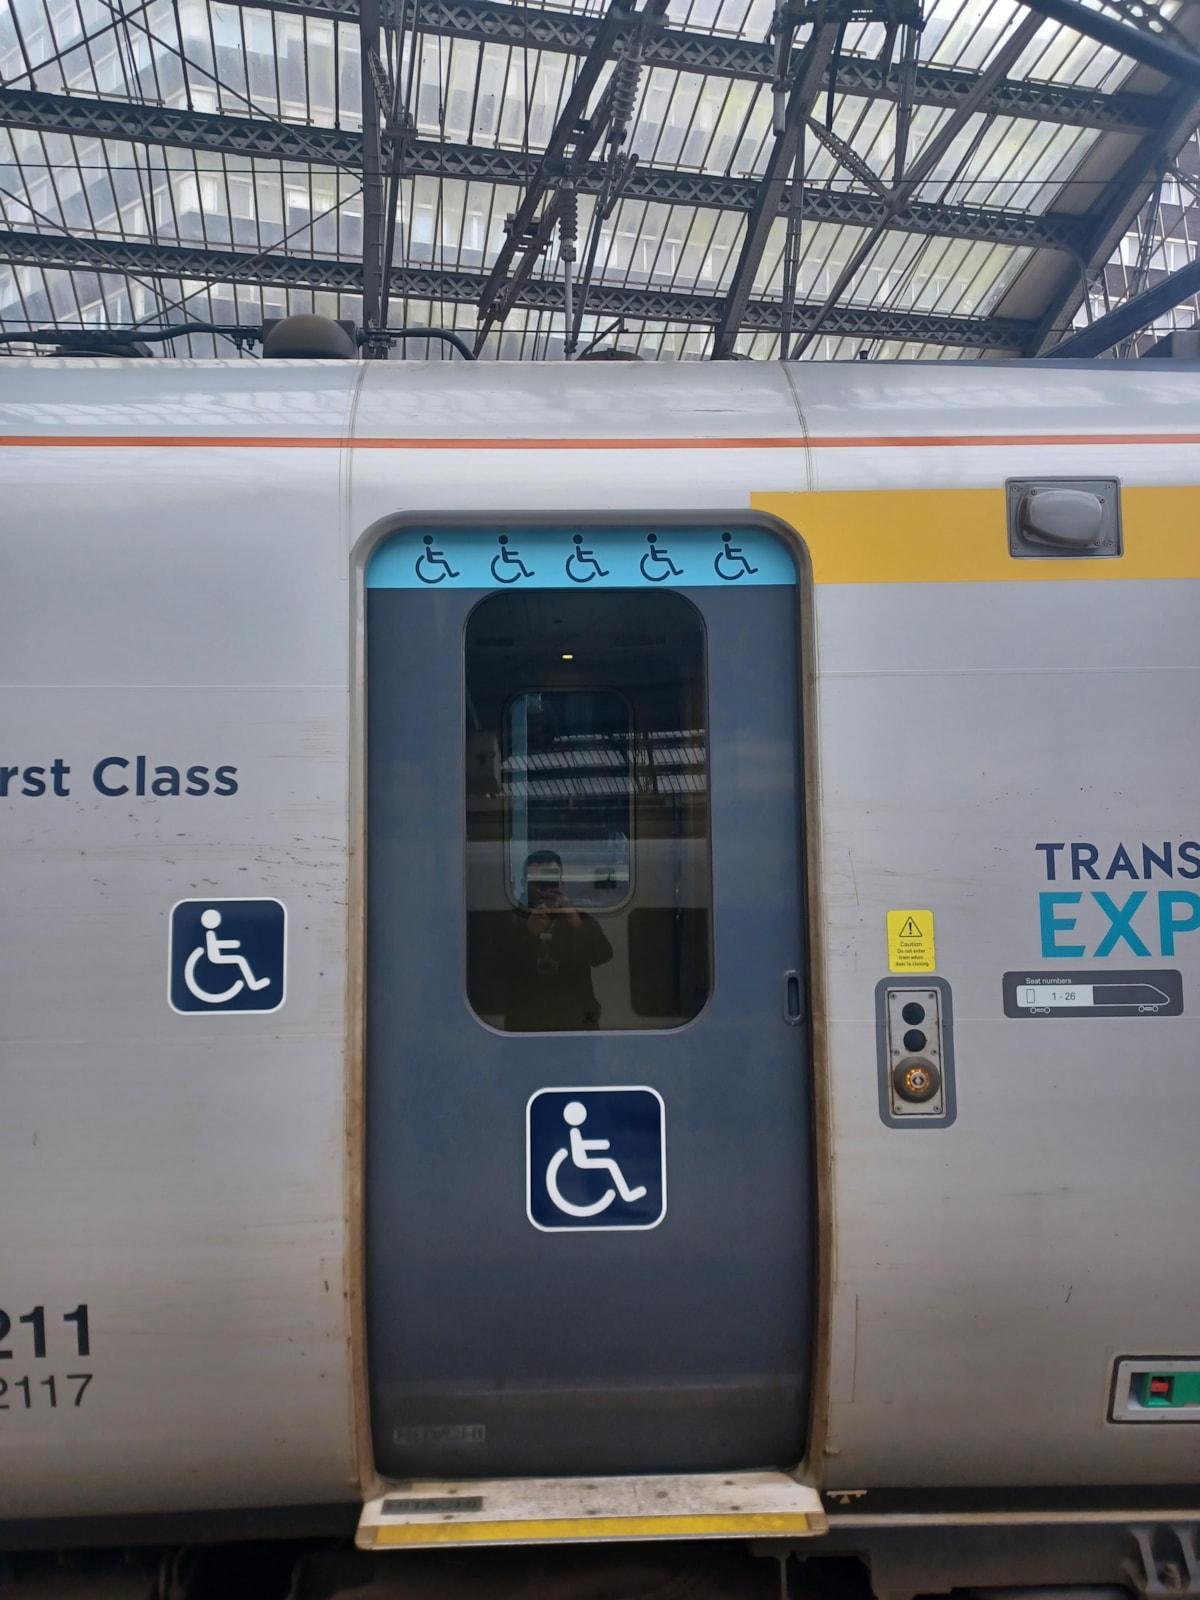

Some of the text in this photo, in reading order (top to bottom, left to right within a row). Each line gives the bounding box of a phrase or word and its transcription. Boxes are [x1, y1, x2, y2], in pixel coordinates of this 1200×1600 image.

[0, 755, 239, 797] rst Class
[1035, 841, 1200, 880] TRANS
[1039, 890, 1200, 958] EXP
[1025, 977, 1072, 985] Seat numbers
[1064, 991, 1076, 1001] 26
